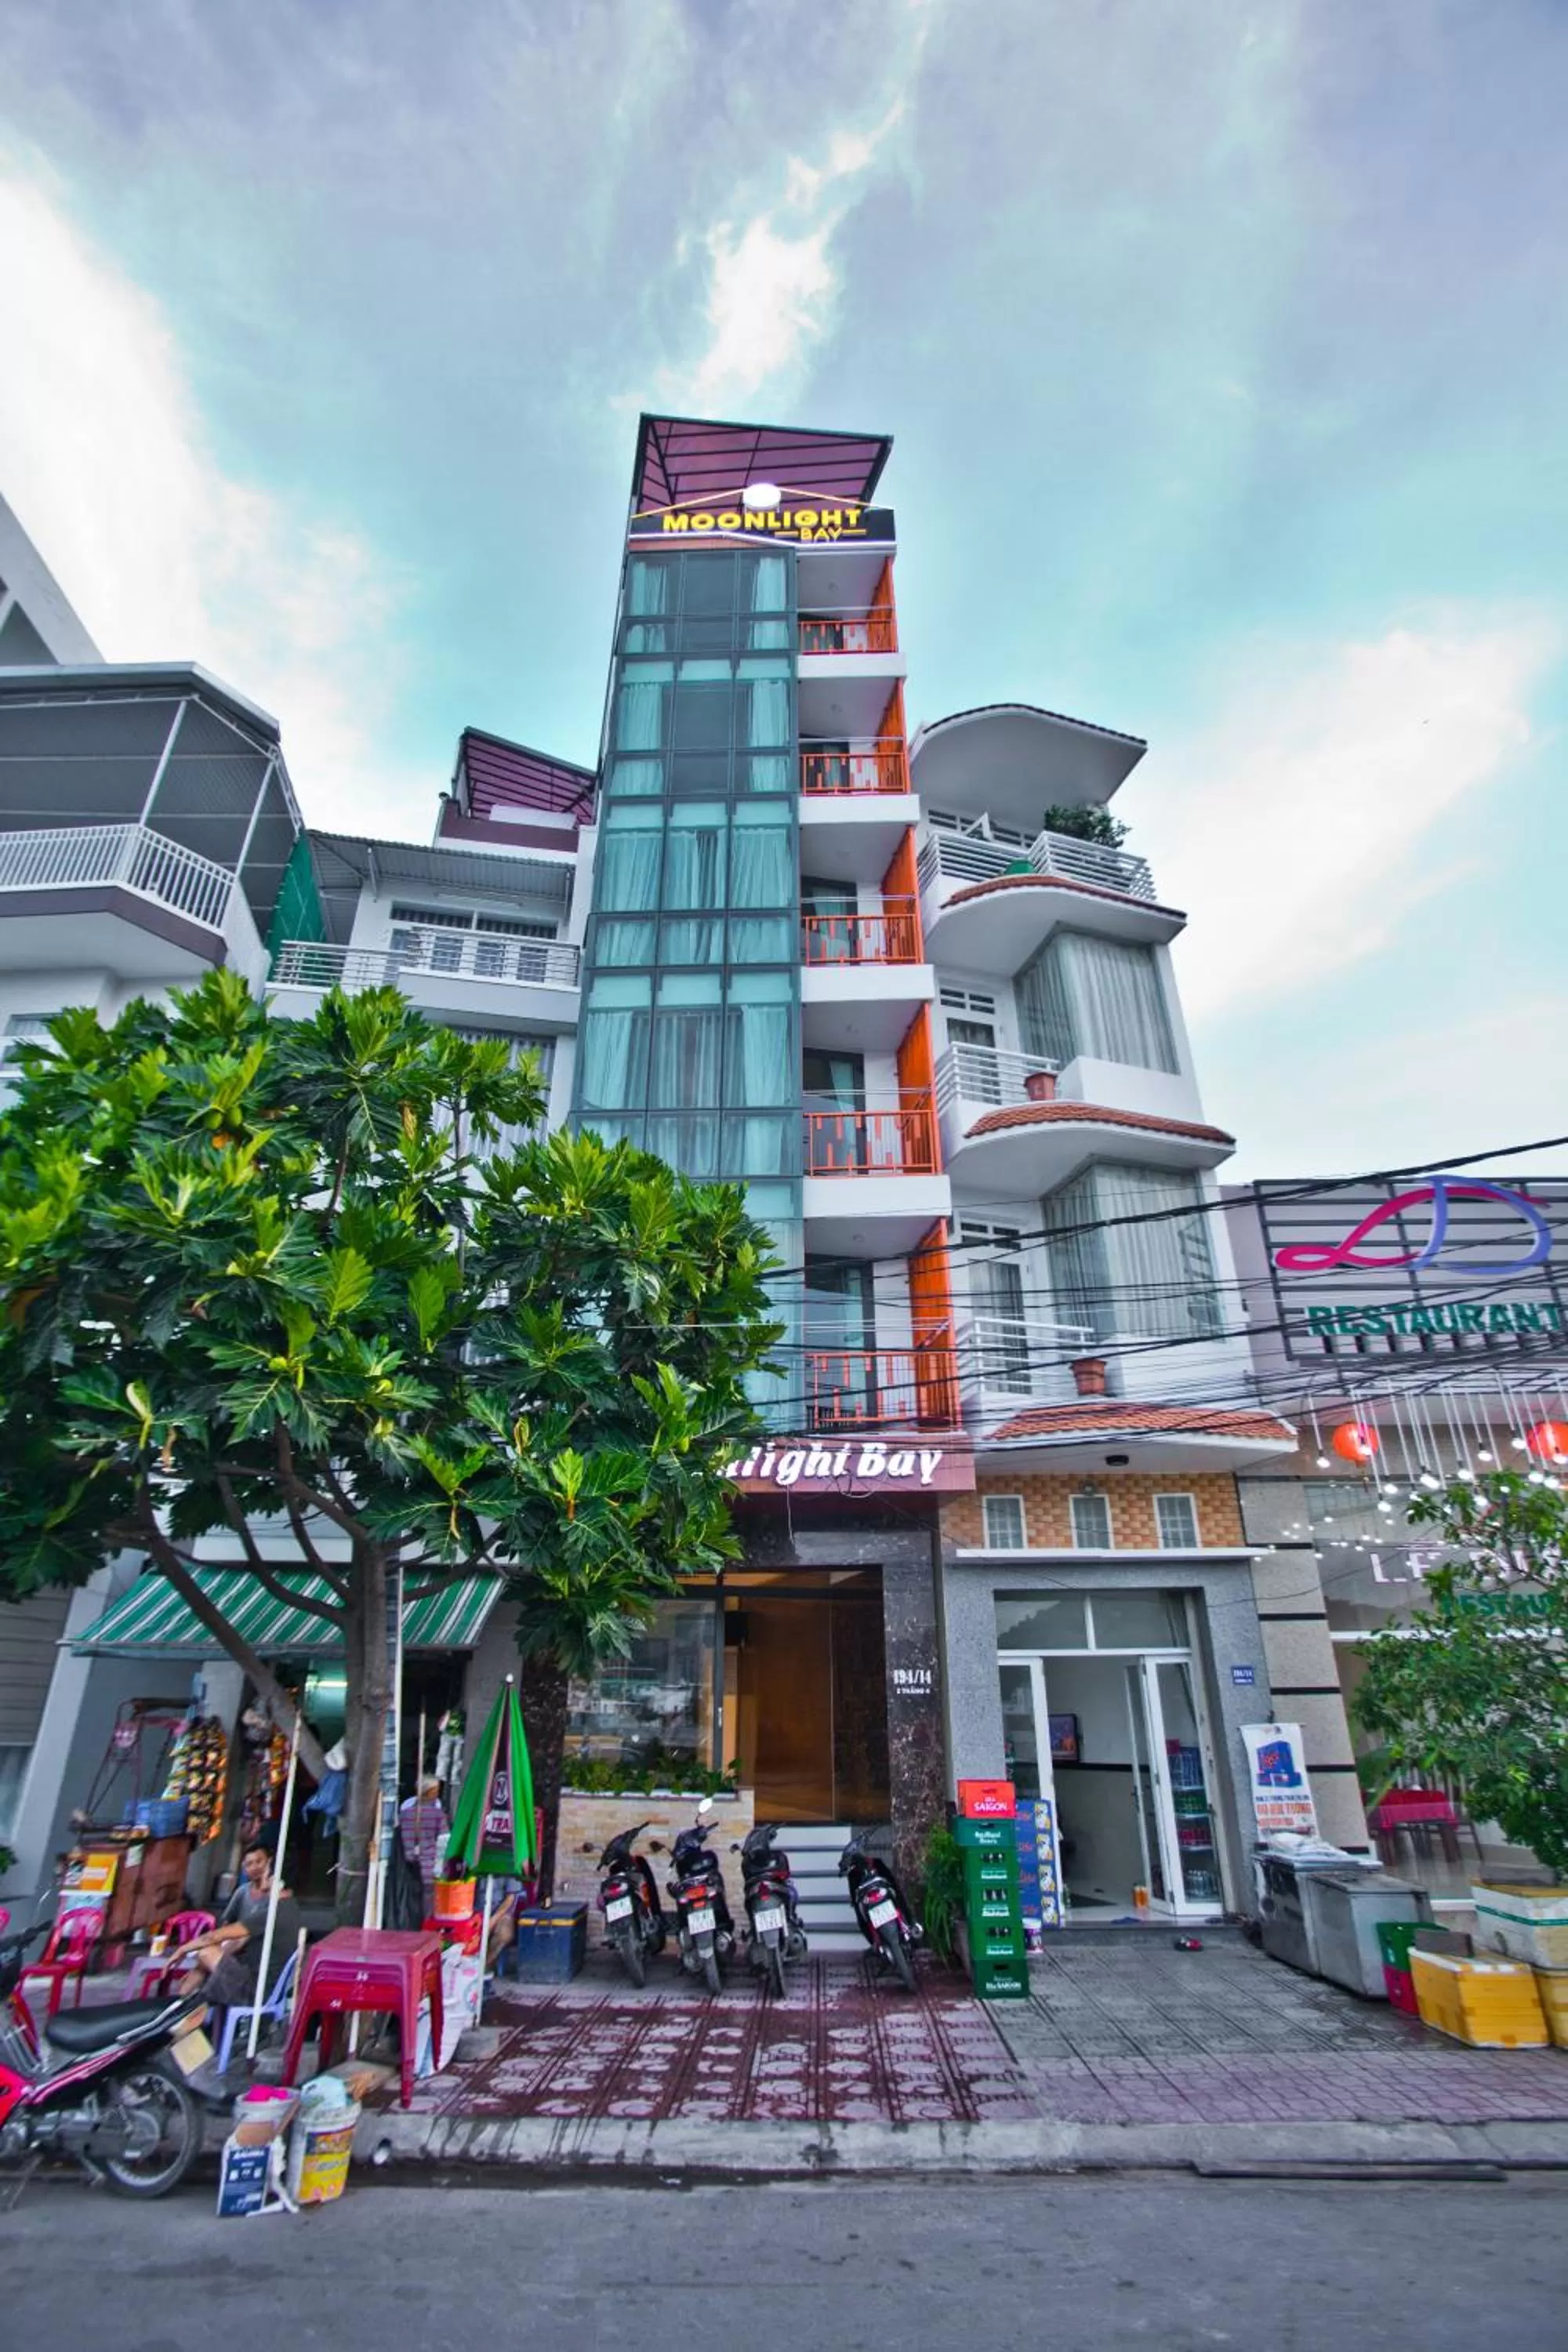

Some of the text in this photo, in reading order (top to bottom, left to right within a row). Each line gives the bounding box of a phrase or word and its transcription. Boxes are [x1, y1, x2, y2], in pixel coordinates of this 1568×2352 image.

[662, 508, 861, 533] MOONLIGHT
[800, 528, 843, 543] BAY
[1305, 1302, 1561, 1335] RESTAURANT
[856, 1443, 942, 1486] Bay
